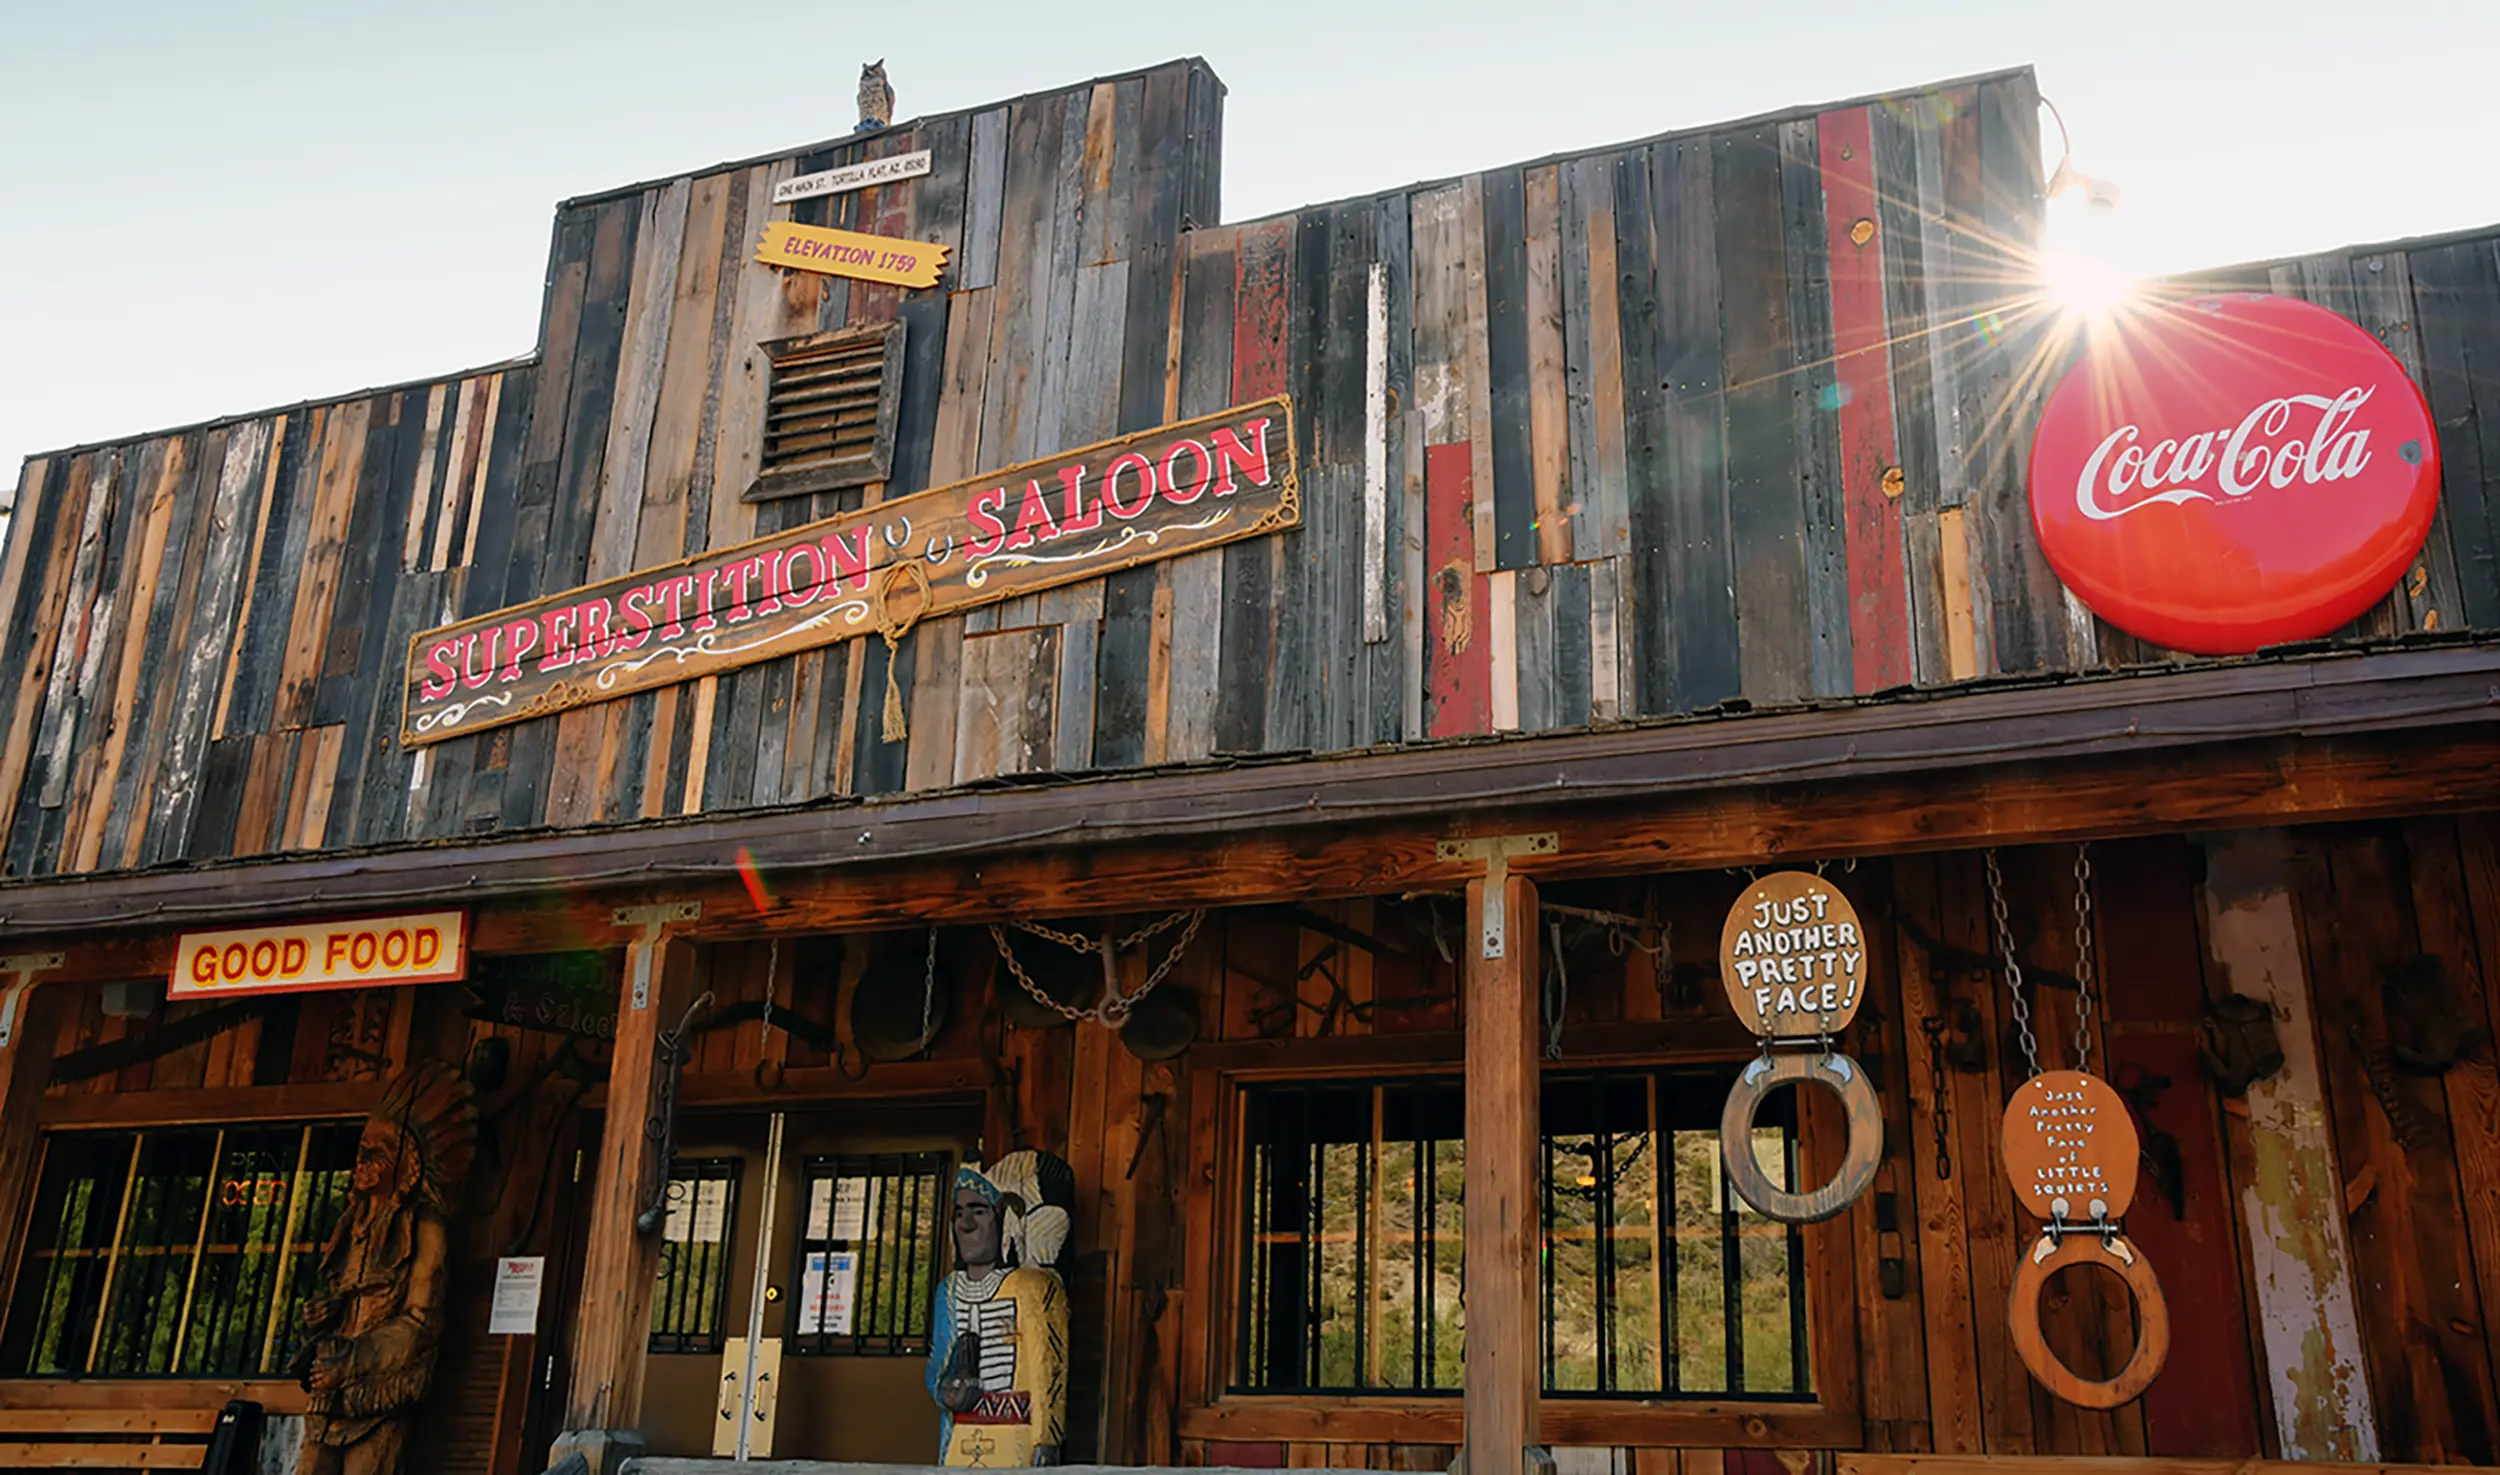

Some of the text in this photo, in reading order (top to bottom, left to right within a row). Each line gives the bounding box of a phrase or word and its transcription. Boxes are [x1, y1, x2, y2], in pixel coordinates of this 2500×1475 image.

[783, 236, 917, 273] ELEVATION 1759
[2076, 384, 2377, 520] Coca-Cola
[419, 417, 1270, 702] SUPERSTITION SALOON
[1753, 894, 1829, 929] JUST
[191, 936, 309, 988] GOOD
[323, 925, 443, 976] FOOD
[1733, 922, 1858, 957] ANOTHER
[1734, 951, 1861, 988] PRETTY
[1754, 979, 1857, 1016] FACE!
[2029, 1105, 2097, 1117] Another
[2045, 1090, 2084, 1102] Just
[2036, 1120, 2094, 1134] Pretty
[2047, 1136, 2086, 1148] Face
[2037, 1166, 2101, 1179] LITTLE
[2059, 1151, 2076, 1164] of
[2033, 1182, 2109, 1196] SQUIRTS
